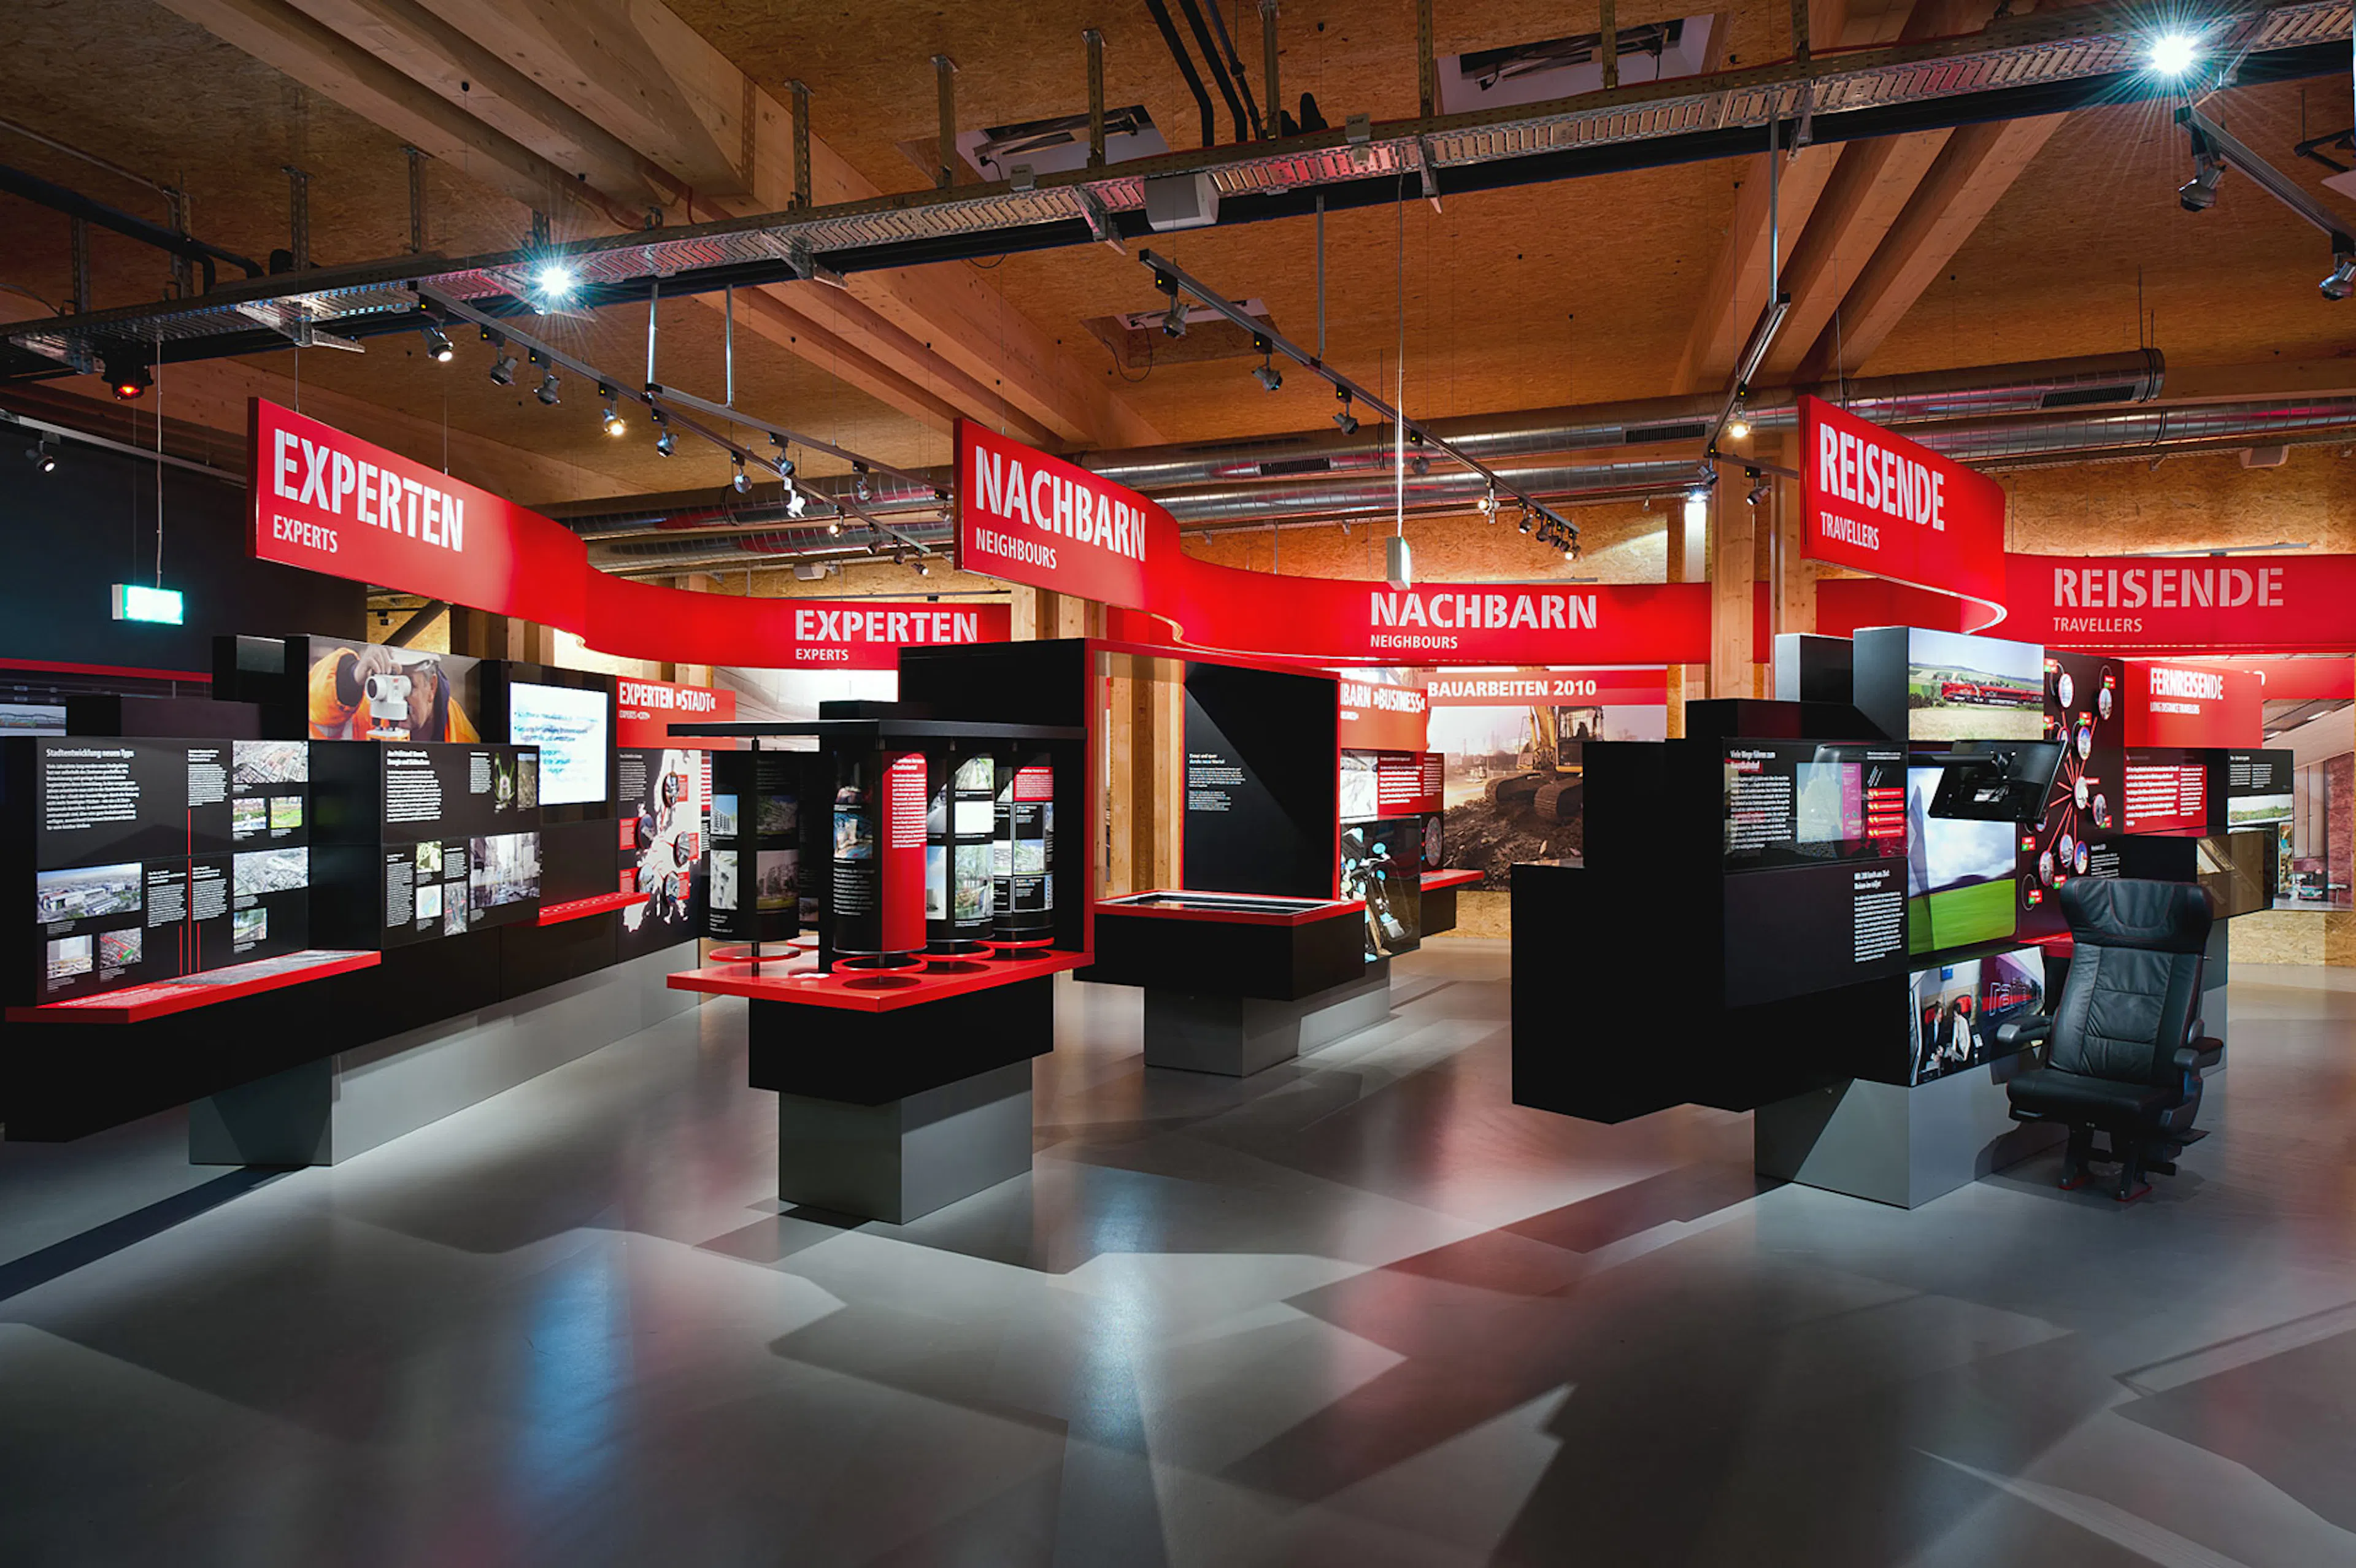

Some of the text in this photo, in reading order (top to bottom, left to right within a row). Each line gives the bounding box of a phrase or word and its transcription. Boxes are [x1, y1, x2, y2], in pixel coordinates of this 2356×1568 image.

[274, 428, 464, 552] EXPERTEN
[1820, 422, 1944, 531] REISENDE
[976, 445, 1147, 562] NACHBARN
[273, 514, 339, 553] EXPERTS
[976, 527, 1058, 569] NEIGHBOURS
[1820, 511, 1879, 551] TRAVELLERS
[2054, 568, 2284, 608] REISENDE
[795, 609, 977, 642] EXPERTEN
[1370, 592, 1597, 629] NACHBARN
[2053, 617, 2143, 632] TRAVELLERS
[796, 648, 850, 661] EXPERTS
[1370, 634, 1458, 649] NEIGHBOURS
[619, 682, 674, 709] EXPERTEN
[1427, 680, 1596, 697] BAUARBEITEN 2010
[2150, 667, 2223, 700] FERNREISENDE
